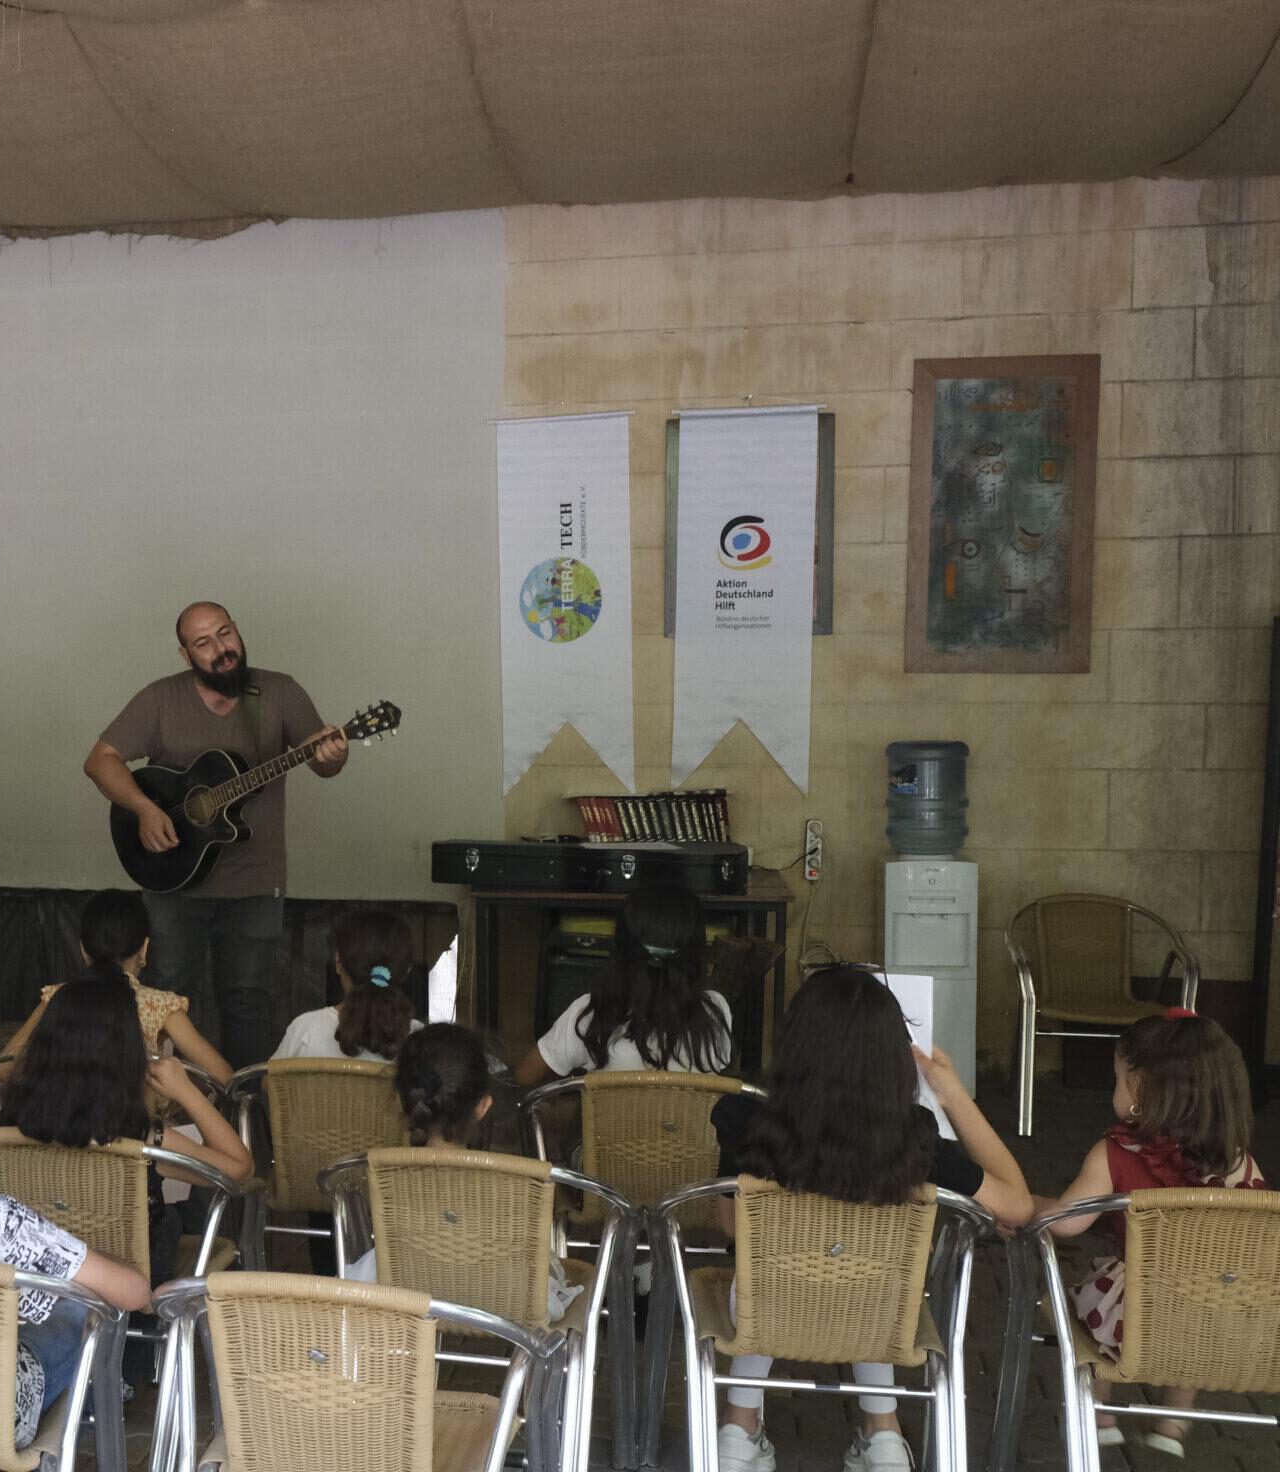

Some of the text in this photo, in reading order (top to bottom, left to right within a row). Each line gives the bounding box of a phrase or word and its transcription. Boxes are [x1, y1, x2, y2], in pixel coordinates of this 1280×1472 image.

[560, 503, 574, 613] TERRA TECH
[716, 580, 747, 588] Aktion
[715, 589, 774, 599] Deutschland
[715, 601, 736, 611] Hilft
